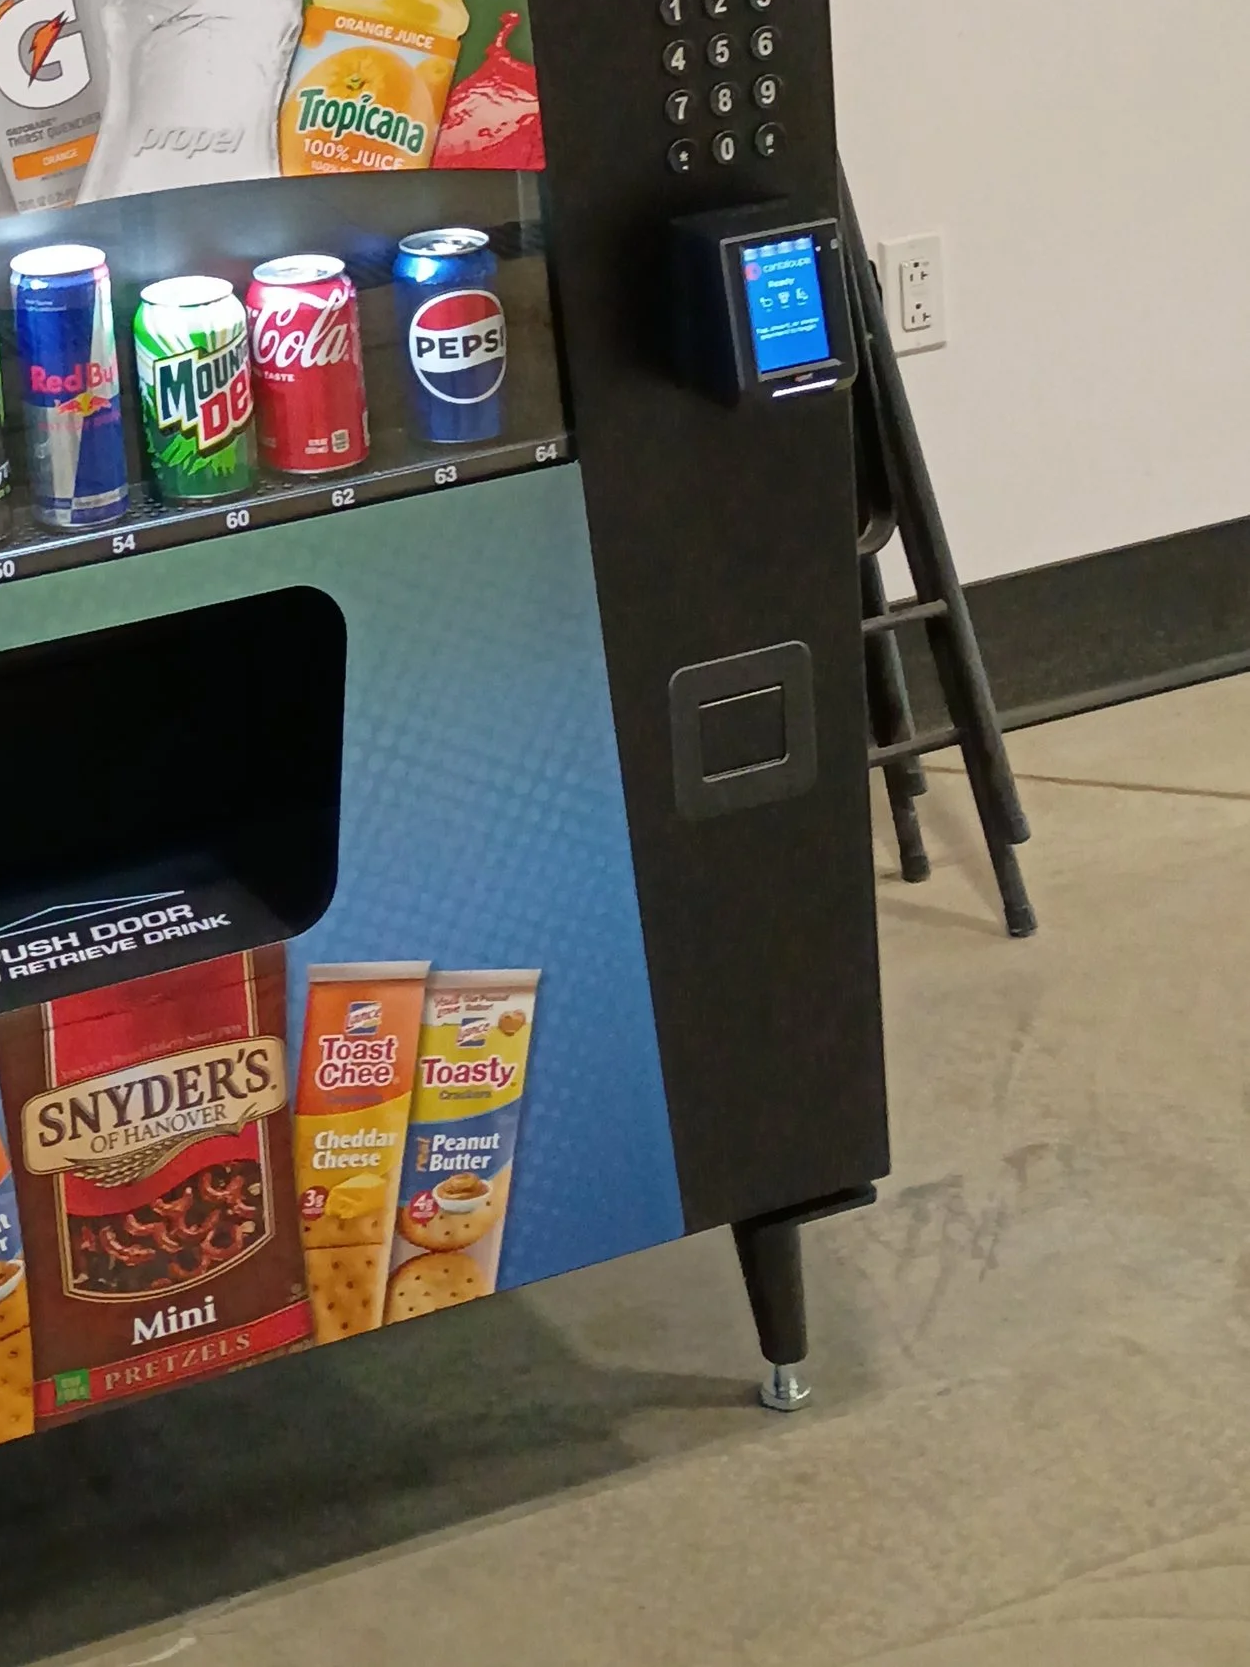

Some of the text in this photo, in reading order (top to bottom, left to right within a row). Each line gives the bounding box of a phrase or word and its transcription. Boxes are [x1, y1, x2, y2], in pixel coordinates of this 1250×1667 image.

[334, 15, 435, 51] ORANGE JUICE
[671, 32, 773, 71] 4 5 6
[674, 80, 776, 121] 7 8 9
[6, 118, 54, 137] GATORADE
[8, 111, 101, 148] THIRST QUENCHER
[295, 86, 427, 155] Tropicana
[133, 124, 245, 159] propel
[302, 137, 405, 171] 100% JUICE
[720, 137, 735, 161] 0
[41, 147, 80, 167] ORANGE
[30, 361, 82, 393] Red
[263, 372, 295, 383] TASTE
[535, 443, 558, 462] 64
[434, 465, 458, 484] 63
[331, 488, 355, 507] 62
[226, 510, 249, 529] 60
[112, 534, 135, 553] 54
[90, 903, 195, 942] DOOR
[8, 939, 139, 980] RETRIEVE
[143, 912, 233, 946] DRINK
[322, 1037, 398, 1062] Toast
[318, 1062, 393, 1088] Chee
[421, 1055, 517, 1089] Toasty
[38, 1047, 270, 1148] SNYDER'S
[438, 1088, 493, 1100] Crackers
[90, 1102, 229, 1154] OF HANOVER
[313, 1127, 398, 1150] Cheddar
[432, 1132, 500, 1151] Peanut
[312, 1150, 381, 1171] Cheese
[428, 1153, 492, 1172] Butter
[130, 1295, 218, 1346] Mini
[104, 1332, 251, 1391] PRETZELS
